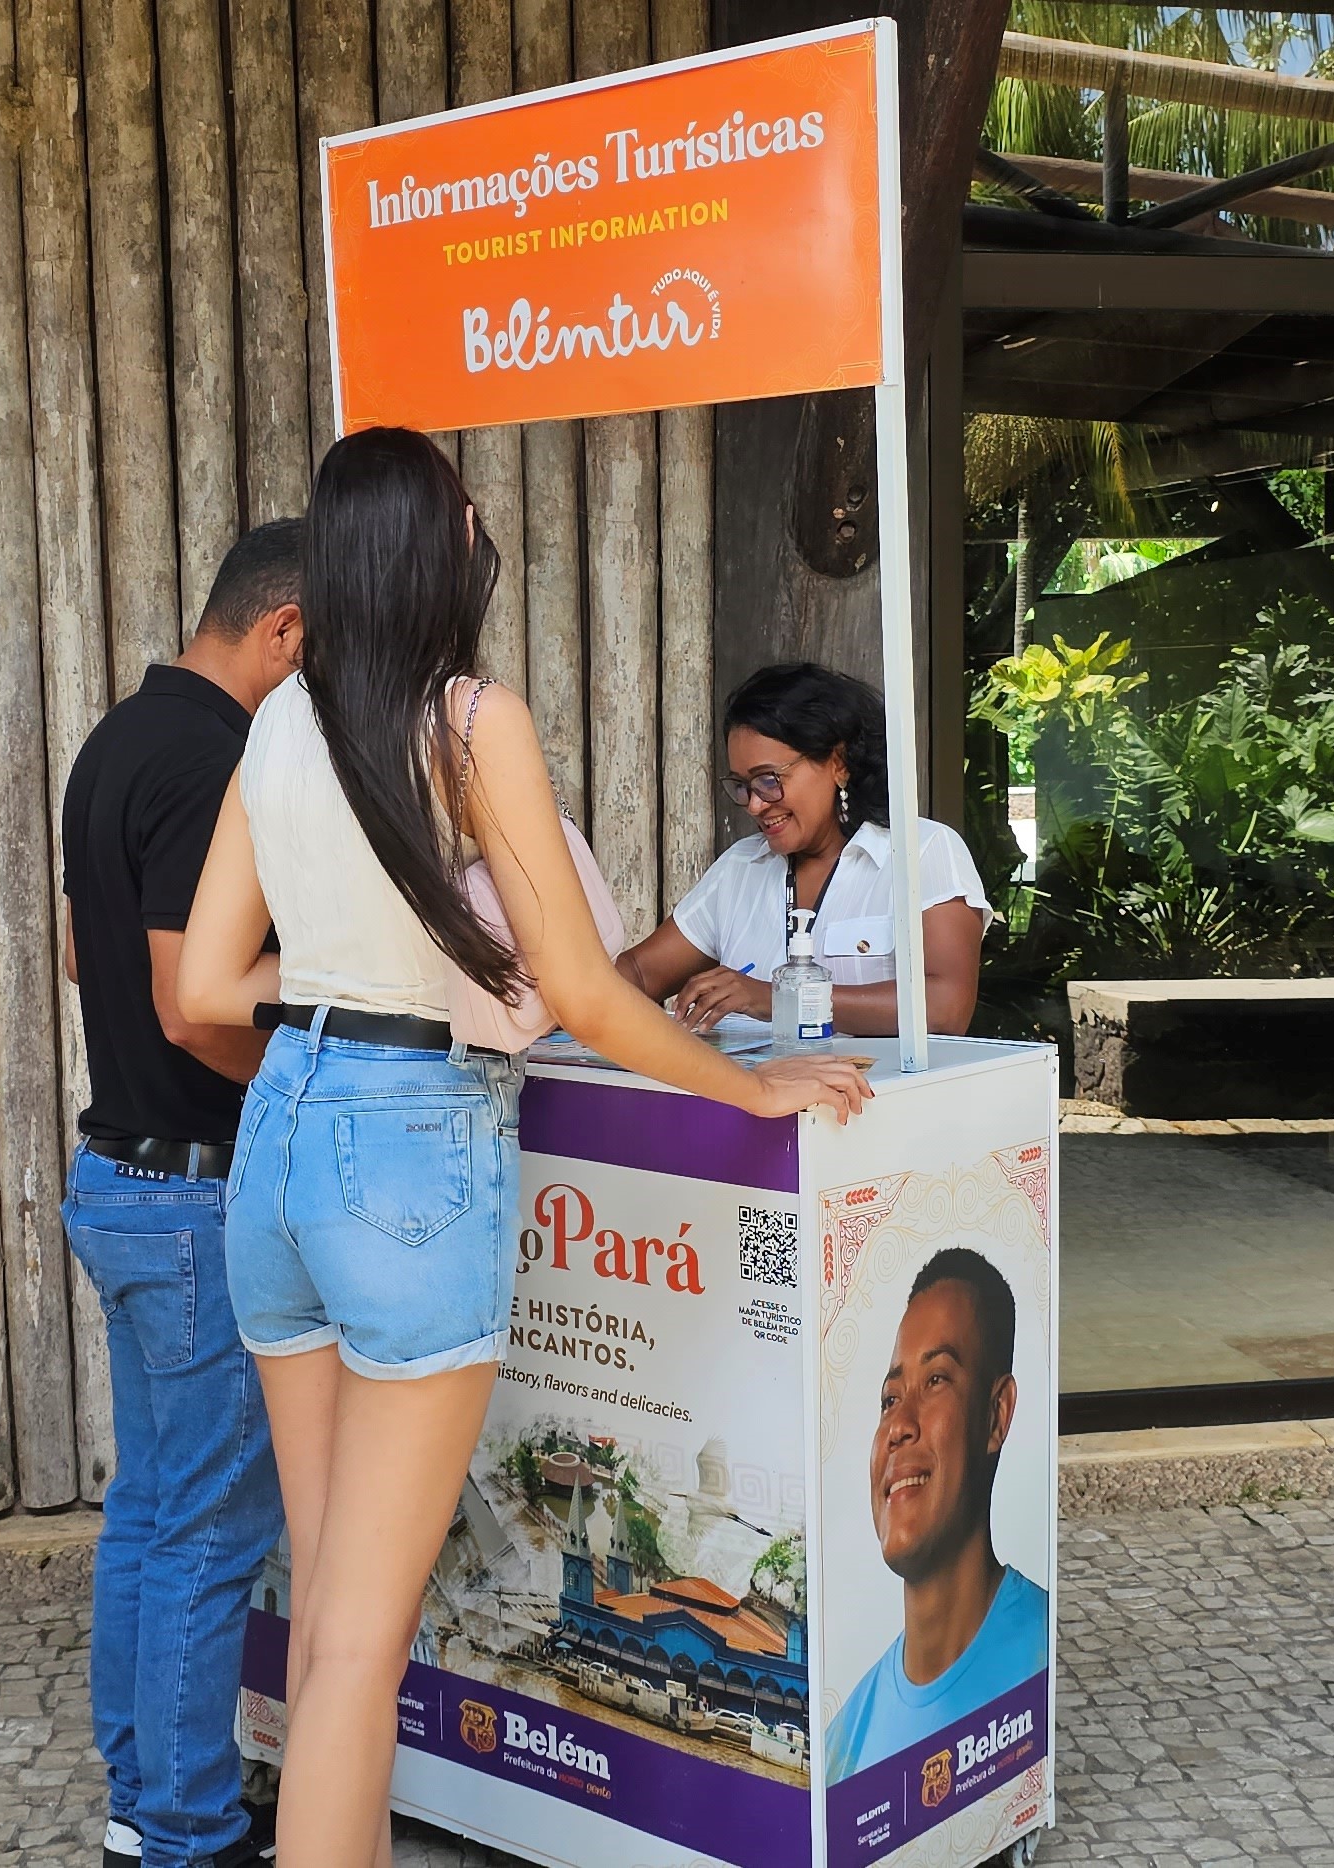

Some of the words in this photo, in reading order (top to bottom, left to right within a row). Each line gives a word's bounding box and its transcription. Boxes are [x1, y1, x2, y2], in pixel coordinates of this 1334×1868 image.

[367, 152, 599, 229] Informações
[605, 110, 825, 184] Turísticas
[443, 229, 542, 265] TOURIST
[550, 198, 728, 248] INFORMATION
[651, 268, 682, 297] TUDO
[683, 267, 711, 292] AQUI
[707, 290, 720, 303] É
[463, 293, 704, 373] Belémtur
[709, 301, 722, 339] VIDA
[118, 1165, 165, 1180] JEANS
[534, 1183, 706, 1295] Pará
[738, 1306, 760, 1318] MAPA
[761, 1310, 802, 1326] TURÍSTICO
[751, 1299, 780, 1312] ACESSE
[781, 1305, 788, 1313] O
[528, 1298, 655, 1350] HISTÓRIA,
[742, 1317, 752, 1327] DE
[754, 1319, 778, 1332] BELÉM
[779, 1325, 798, 1336] PELO
[754, 1330, 765, 1340] QR
[766, 1333, 788, 1345] CODE
[509, 1324, 634, 1372] NCANTOS.
[544, 1374, 589, 1398] flavors
[591, 1388, 618, 1405] and
[620, 1393, 693, 1423] delicacies.
[503, 1711, 611, 1781] Belém
[956, 1709, 1034, 1776] Belém
[503, 1752, 545, 1775] Prefeitura
[546, 1767, 557, 1780] da
[955, 1770, 987, 1796] Prefeitura
